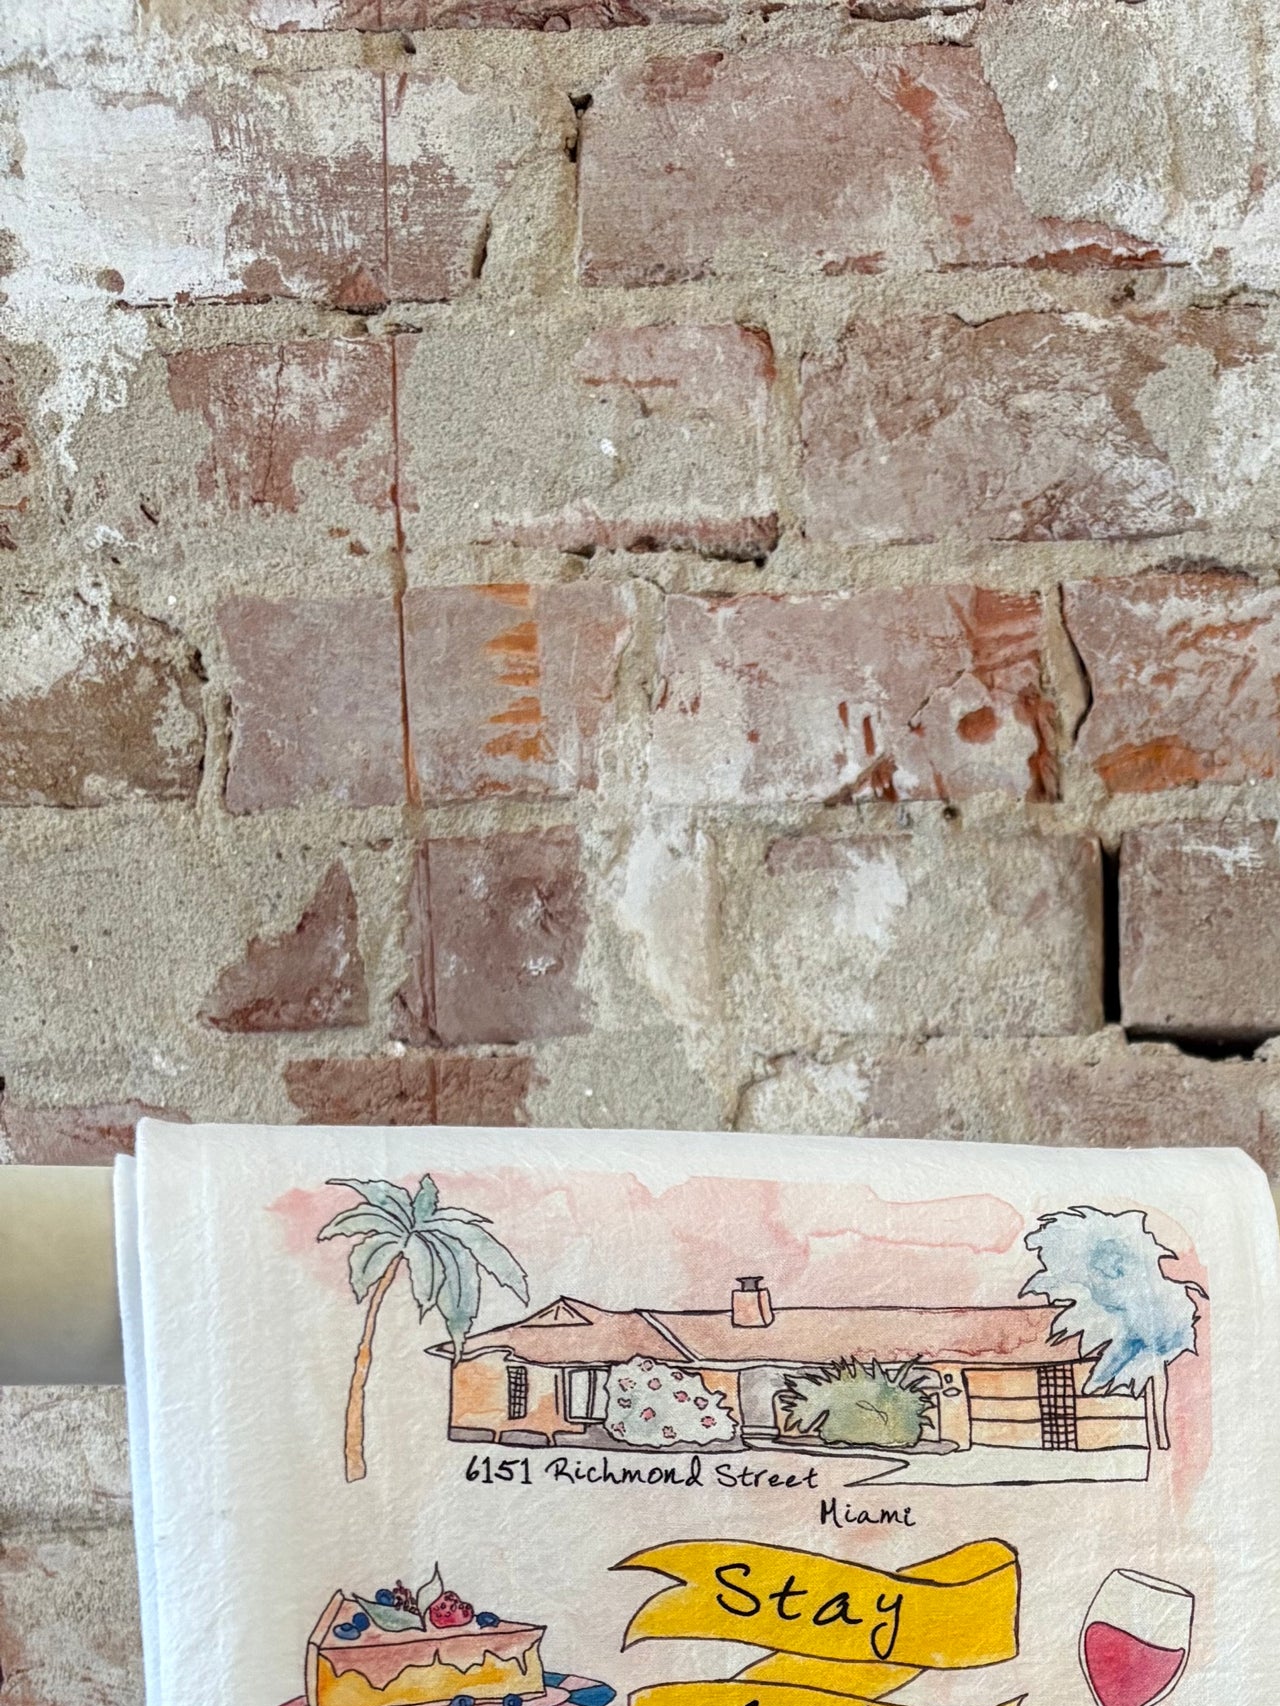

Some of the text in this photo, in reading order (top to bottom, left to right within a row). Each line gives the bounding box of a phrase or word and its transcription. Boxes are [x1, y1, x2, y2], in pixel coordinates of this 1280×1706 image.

[465, 1454, 819, 1489] 6151 Richmond Street
[820, 1497, 916, 1529] Miami
[714, 1562, 906, 1661] Stay
